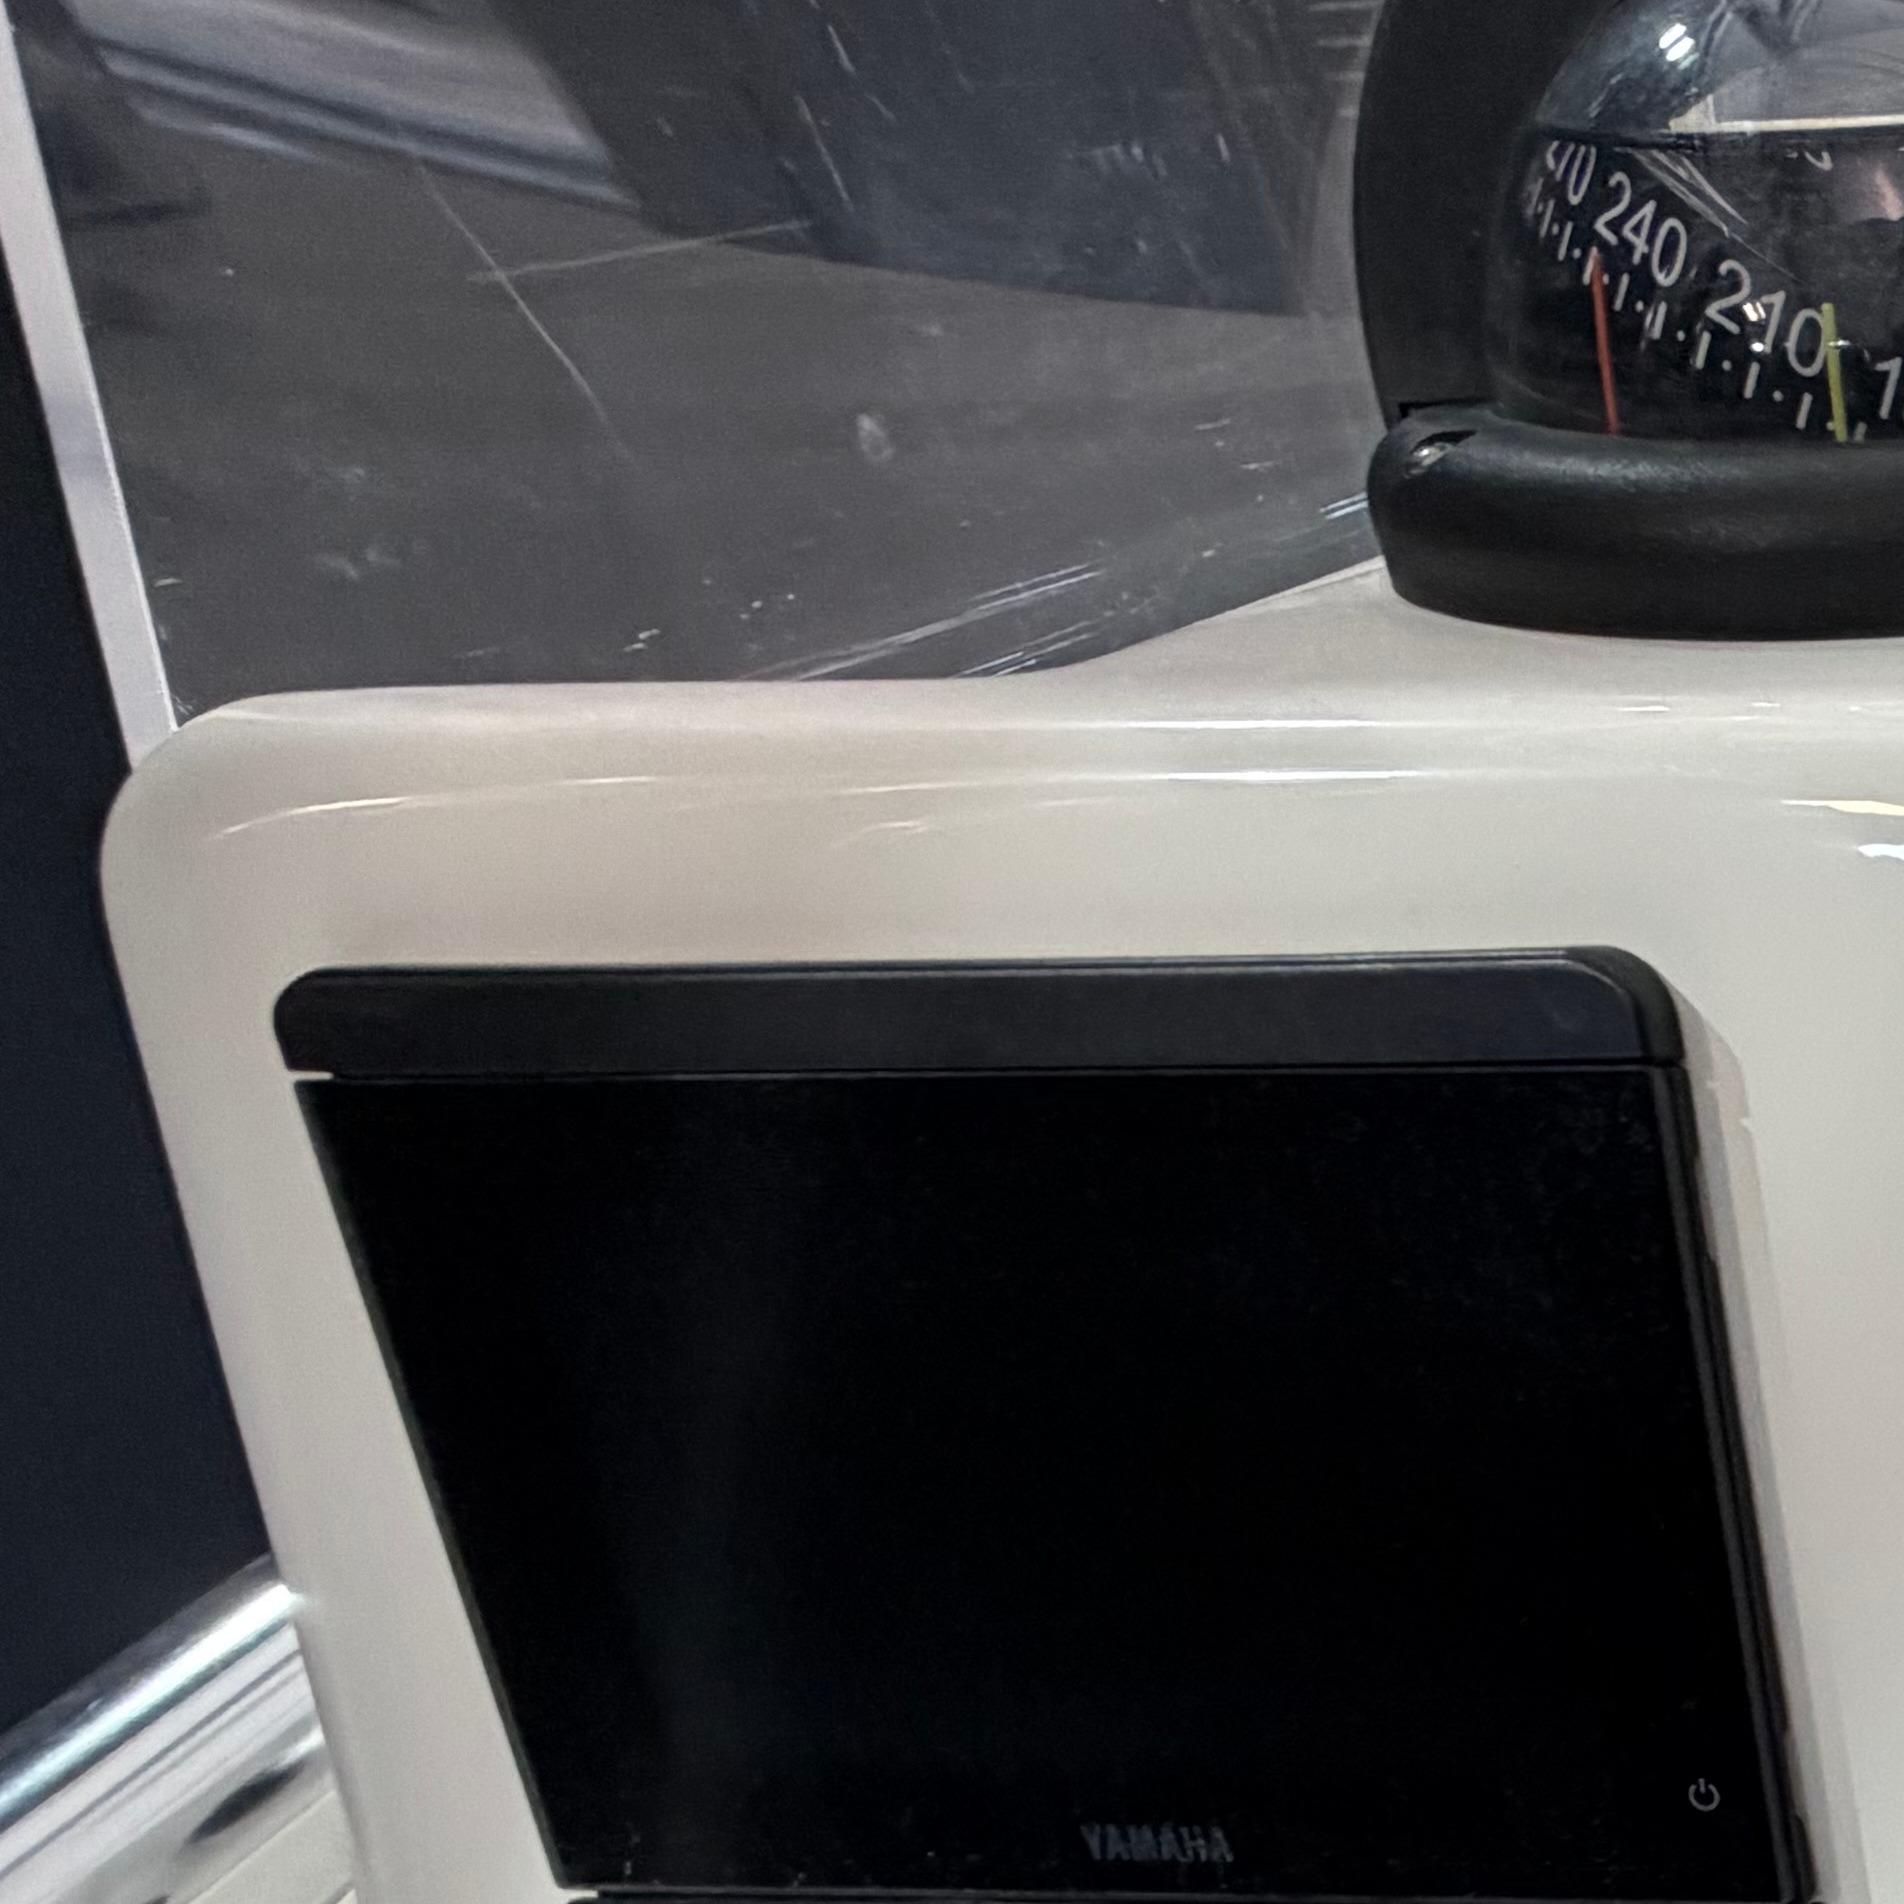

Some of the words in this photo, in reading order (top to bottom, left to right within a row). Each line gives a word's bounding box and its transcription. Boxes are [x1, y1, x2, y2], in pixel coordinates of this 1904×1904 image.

[1593, 171, 1687, 287] 240
[1704, 259, 1826, 377] 210
[1080, 1822, 1234, 1863] YAMAHA
